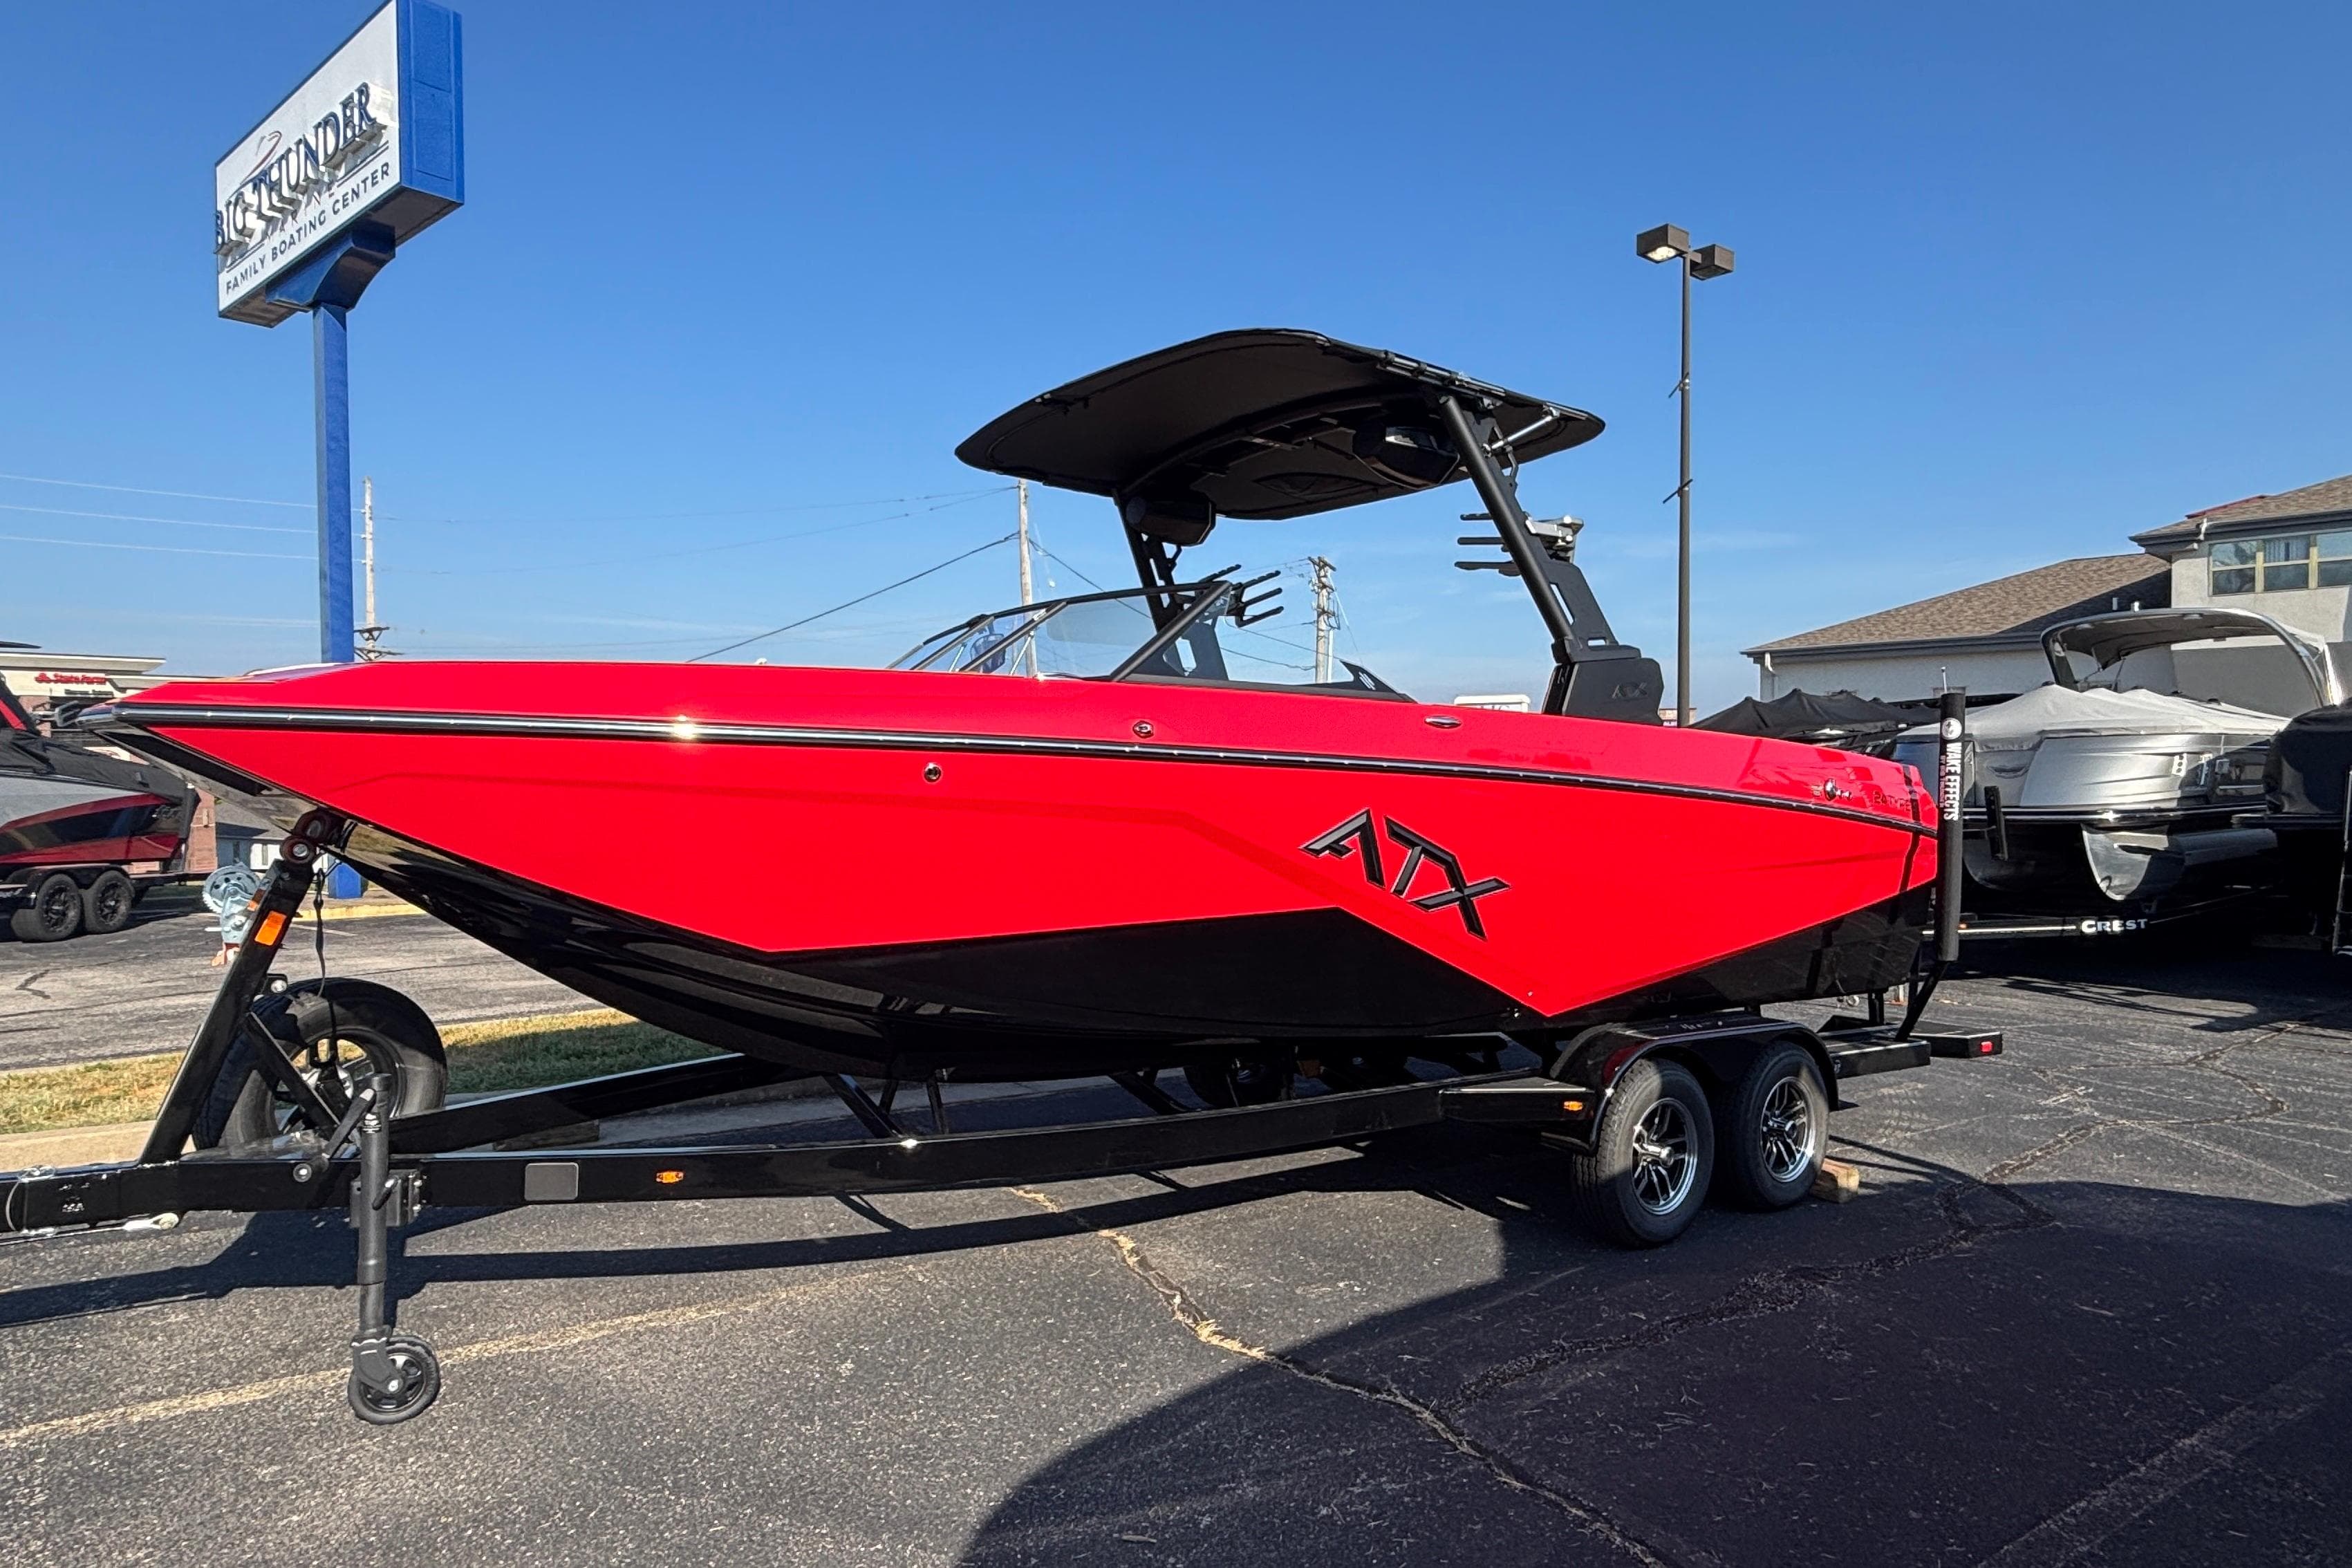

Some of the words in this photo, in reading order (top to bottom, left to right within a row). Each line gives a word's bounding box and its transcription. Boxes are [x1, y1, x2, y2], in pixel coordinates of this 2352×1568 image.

[252, 81, 377, 220] THUNDER
[226, 254, 265, 295] FAMILY
[272, 209, 326, 261] BOATING
[332, 162, 389, 216] CENTER
[1943, 775, 1960, 821] EFFECTS
[1945, 742, 1962, 774] WAKE
[1298, 808, 1512, 942] ATX
[2081, 918, 2148, 933] CREST
